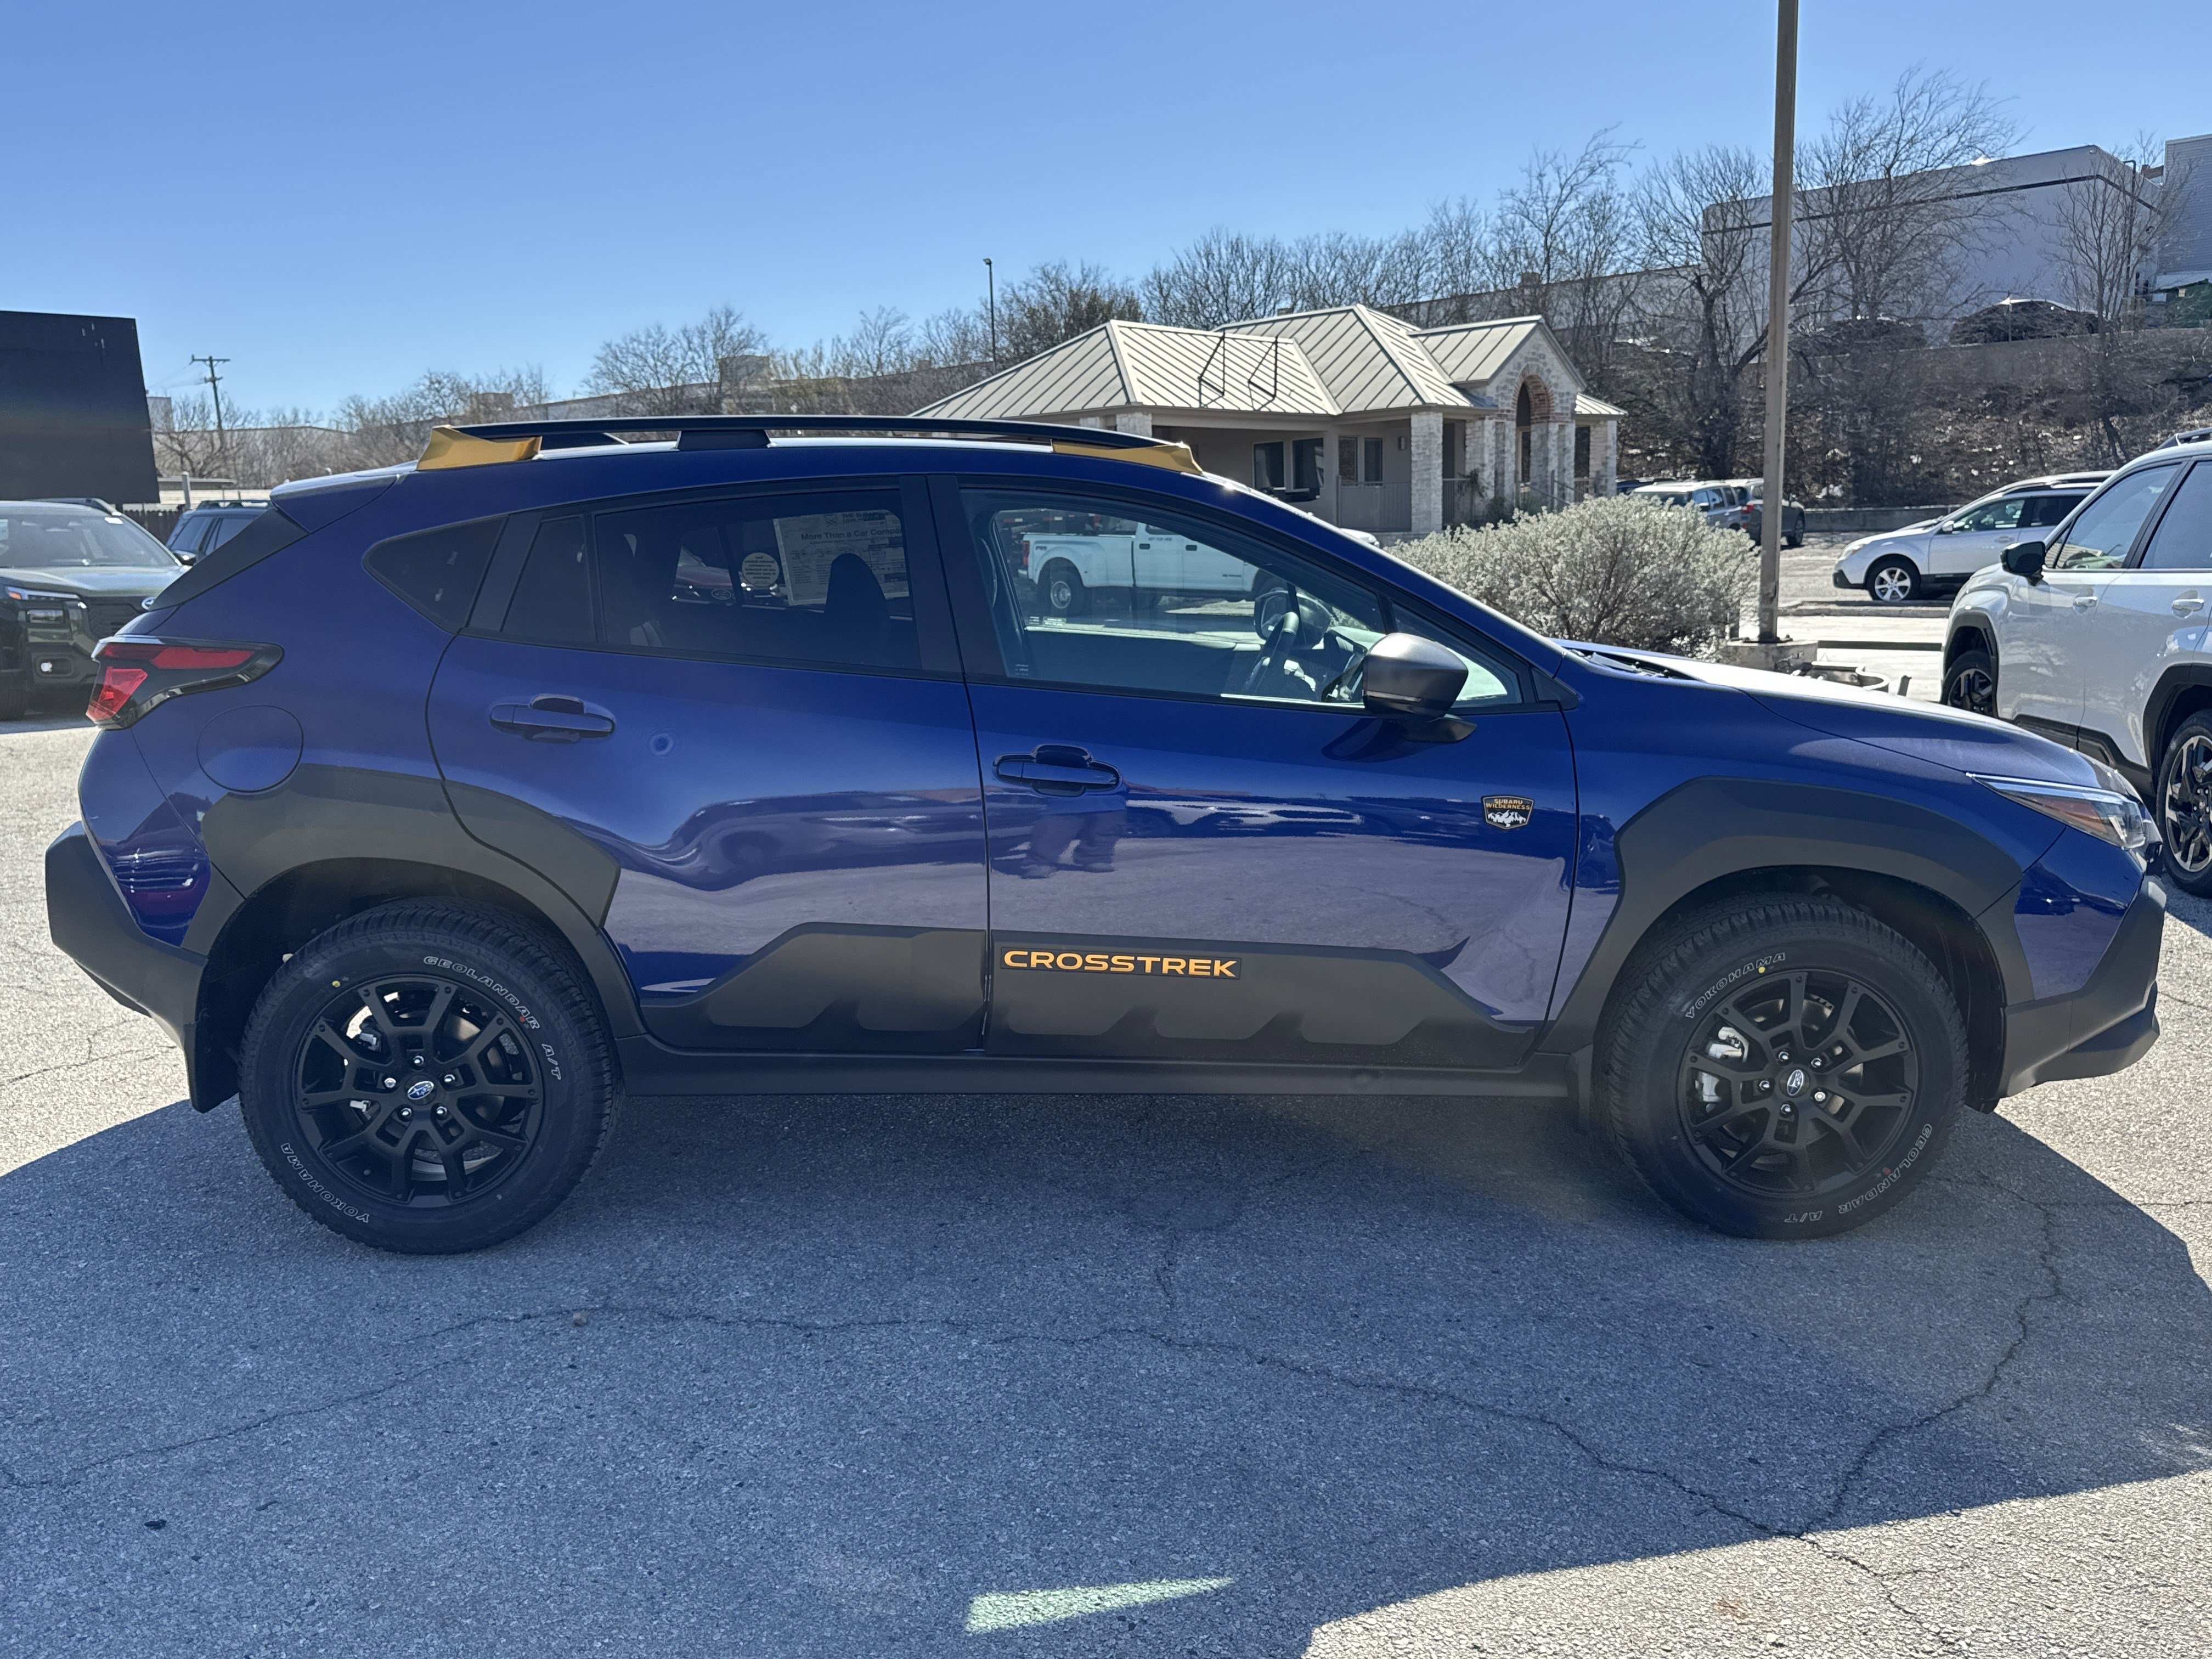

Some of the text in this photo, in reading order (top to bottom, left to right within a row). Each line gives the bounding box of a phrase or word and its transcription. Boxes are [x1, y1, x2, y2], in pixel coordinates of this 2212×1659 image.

[1003, 950, 1238, 978] CROSSTREK
[1685, 952, 1786, 1019] YOKOHAMA
[423, 956, 562, 1080] GEOLANDAR A/T
[280, 1142, 371, 1223] YOKOHAMA
[1784, 1123, 1933, 1223] GEOLANDAR A/T
